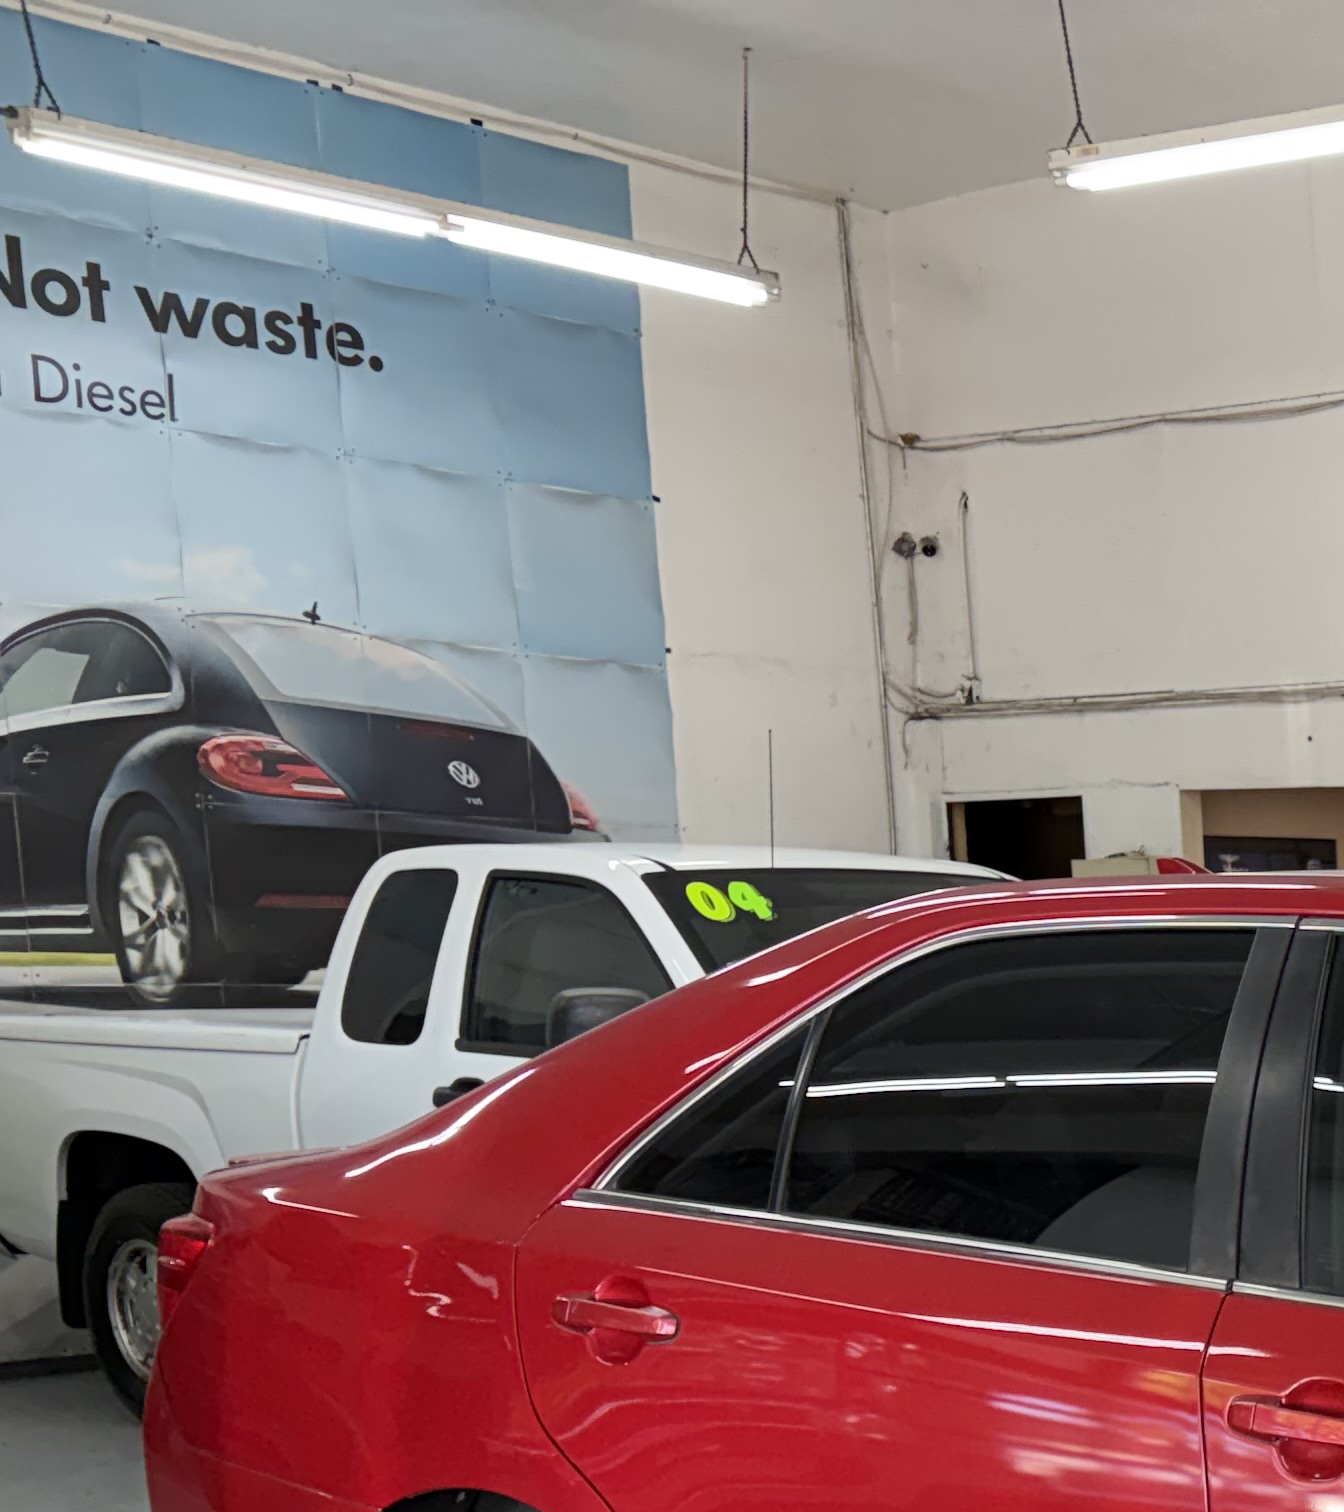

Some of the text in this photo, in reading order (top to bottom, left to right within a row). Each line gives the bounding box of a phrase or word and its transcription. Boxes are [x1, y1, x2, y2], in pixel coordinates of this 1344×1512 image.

[133, 285, 384, 372] waste.
[31, 353, 178, 422] Diesel
[686, 881, 774, 922] 04
